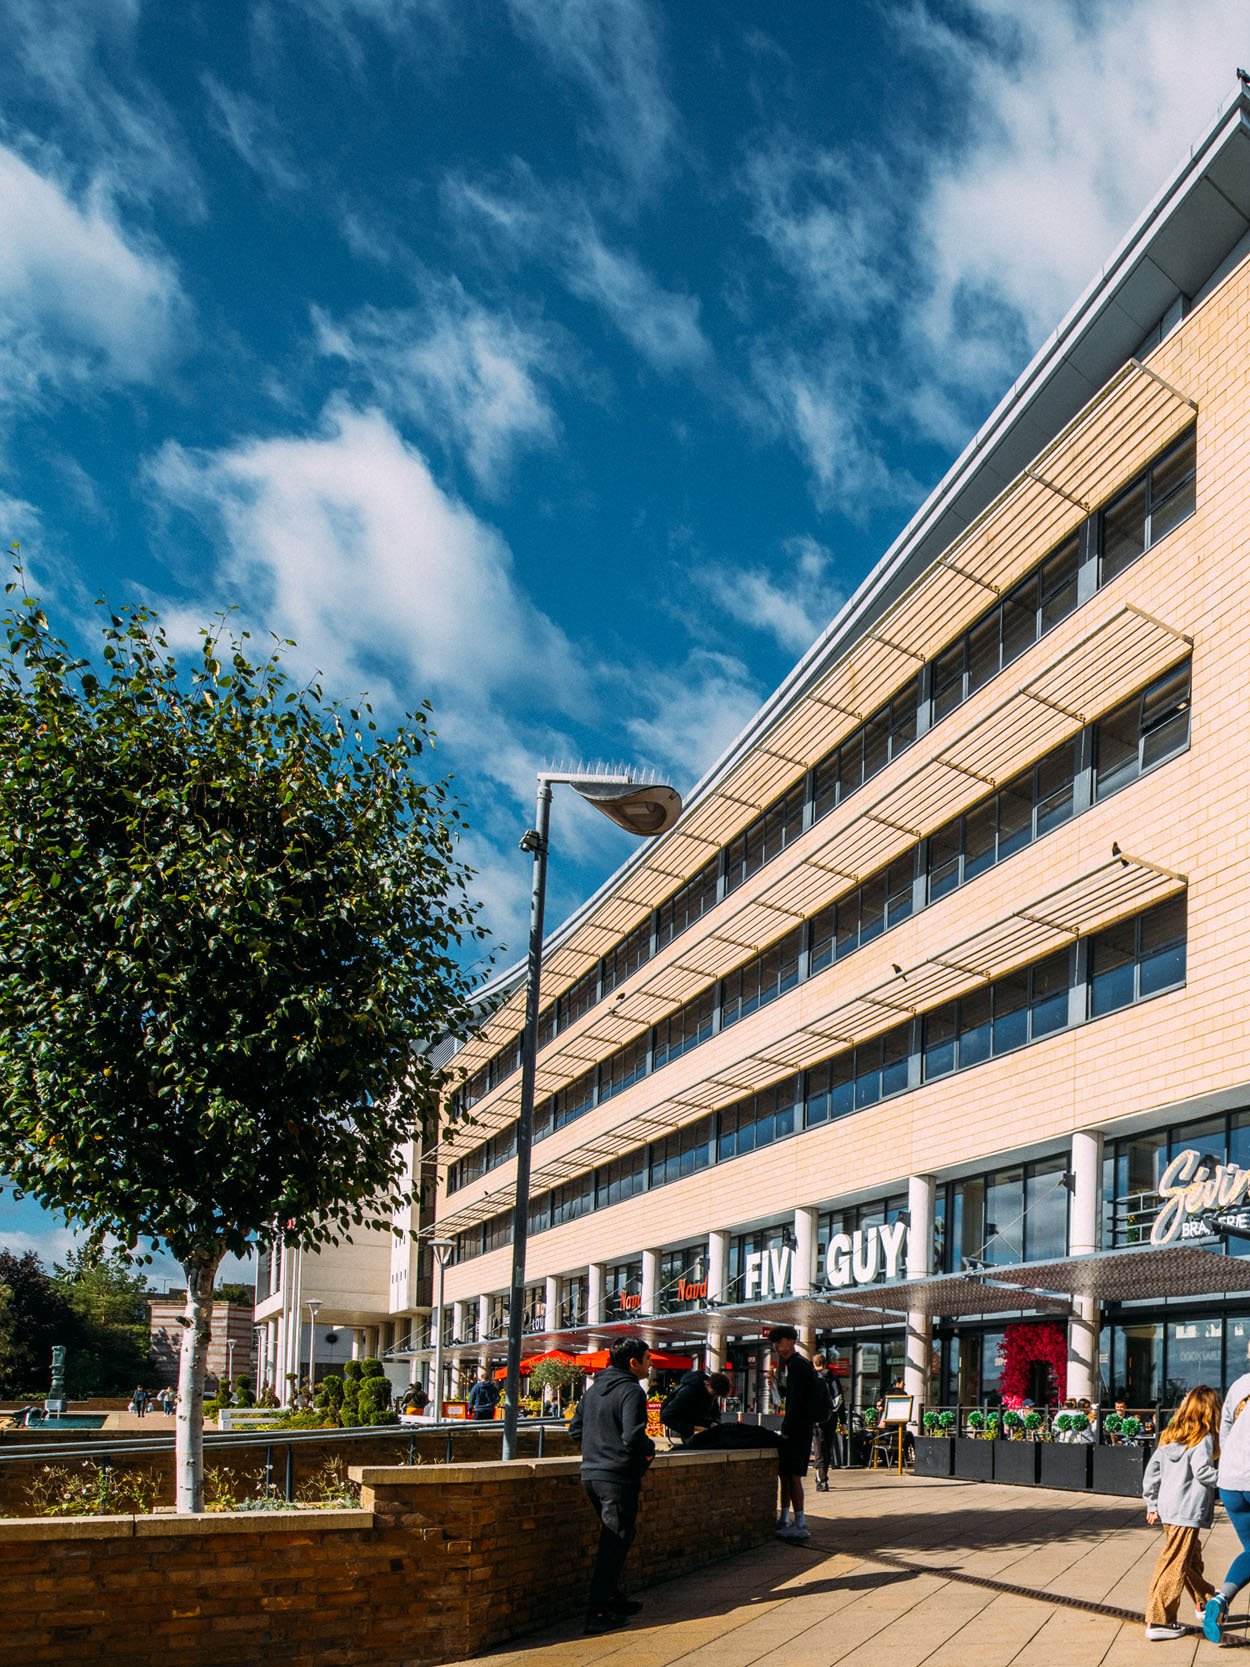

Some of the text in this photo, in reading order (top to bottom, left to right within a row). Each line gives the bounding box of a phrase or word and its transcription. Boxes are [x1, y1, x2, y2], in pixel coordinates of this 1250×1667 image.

[1181, 1213, 1248, 1237] BRAERIE
[745, 1222, 909, 1299] FIV GUY
